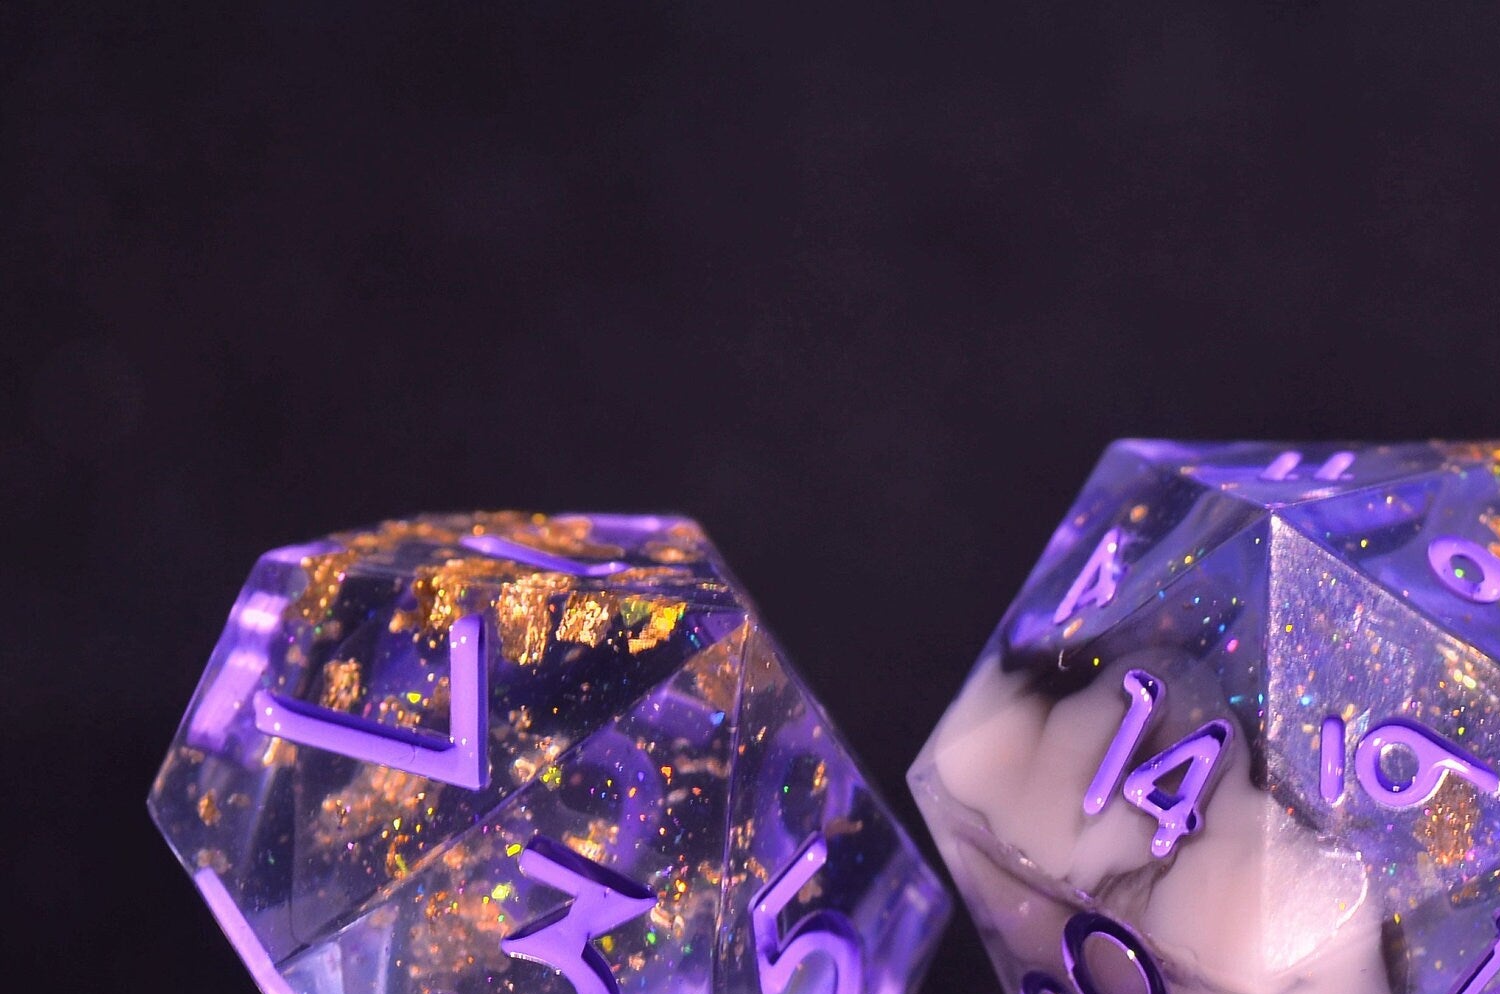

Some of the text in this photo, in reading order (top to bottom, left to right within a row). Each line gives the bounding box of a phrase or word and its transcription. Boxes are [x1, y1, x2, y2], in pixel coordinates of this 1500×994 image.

[1053, 528, 1132, 624] 4
[254, 614, 490, 790] 7
[1083, 669, 1235, 858] 14
